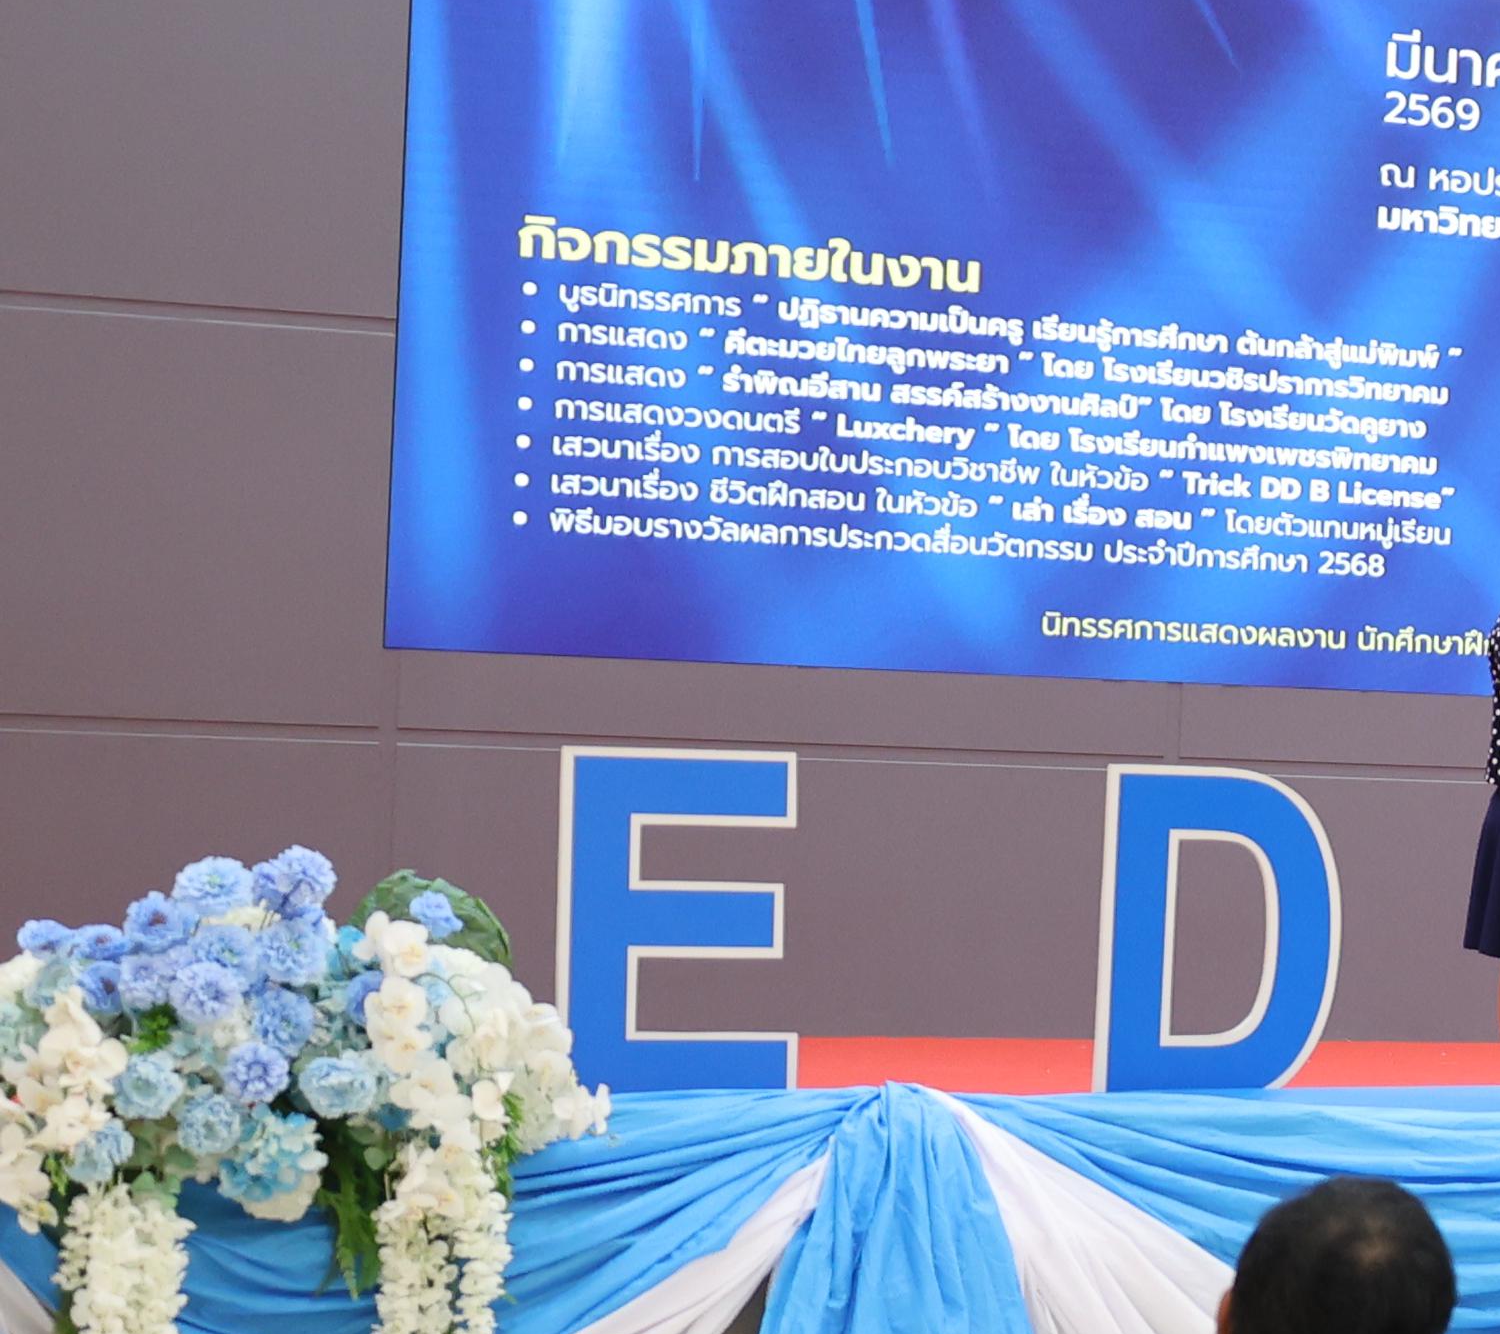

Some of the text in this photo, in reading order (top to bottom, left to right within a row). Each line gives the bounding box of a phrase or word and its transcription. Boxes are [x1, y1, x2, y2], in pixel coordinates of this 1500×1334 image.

[1382, 90, 1482, 133] 2569
[1379, 162, 1415, 190] ณ
[517, 215, 982, 294] กิจกรรมภายในงาน
[558, 322, 688, 350] การแสดง
[1041, 351, 1094, 380] โดย
[1101, 356, 1449, 405] โรงเรียนวชิรปราการวิทยาคม
[559, 282, 742, 317] บูธนิทรรศการ
[1032, 314, 1229, 354] เรียนรู้การศึกษา
[1236, 329, 1440, 370] ต้นกล้าสู่แม่พิมพ์
[555, 399, 801, 434] การแสดงวงดนตรี
[836, 413, 976, 451] Luxchery
[1007, 423, 1060, 451] โดย
[1068, 426, 1438, 475] โรงเรียนกำแพงเพชรพิทยาคม
[556, 360, 686, 388] การแสดง
[1160, 397, 1211, 425] โดย
[1218, 401, 1427, 444] โรงเรียนวัดคูยาง
[553, 429, 700, 464] เสวนาเรื่อง
[712, 446, 1041, 485] การสอบใบประกอบวิชาชีพ
[1050, 461, 1149, 492] ในหัวข้อ
[1182, 471, 1252, 498] Trick
[1260, 475, 1302, 501] DD
[1309, 479, 1330, 503] B
[550, 506, 1385, 578] พิธีมอบรางวัลผลการประกวดสื่อนวัตกรรม ประจำปีการศึกษา 2568
[551, 467, 699, 502] เสวนาเรื่อง
[710, 477, 866, 511] ชีวิตฝึกสอน
[875, 487, 978, 518] ในหัวข้อ
[1012, 495, 1054, 522] เล่า
[1063, 493, 1127, 527] เรื่อง
[1135, 508, 1192, 530] สอน
[1225, 508, 1451, 550] โดยตัวแทนหมู่เรียน
[1041, 610, 1347, 651] นิทรรศการแสดงผลงาน
